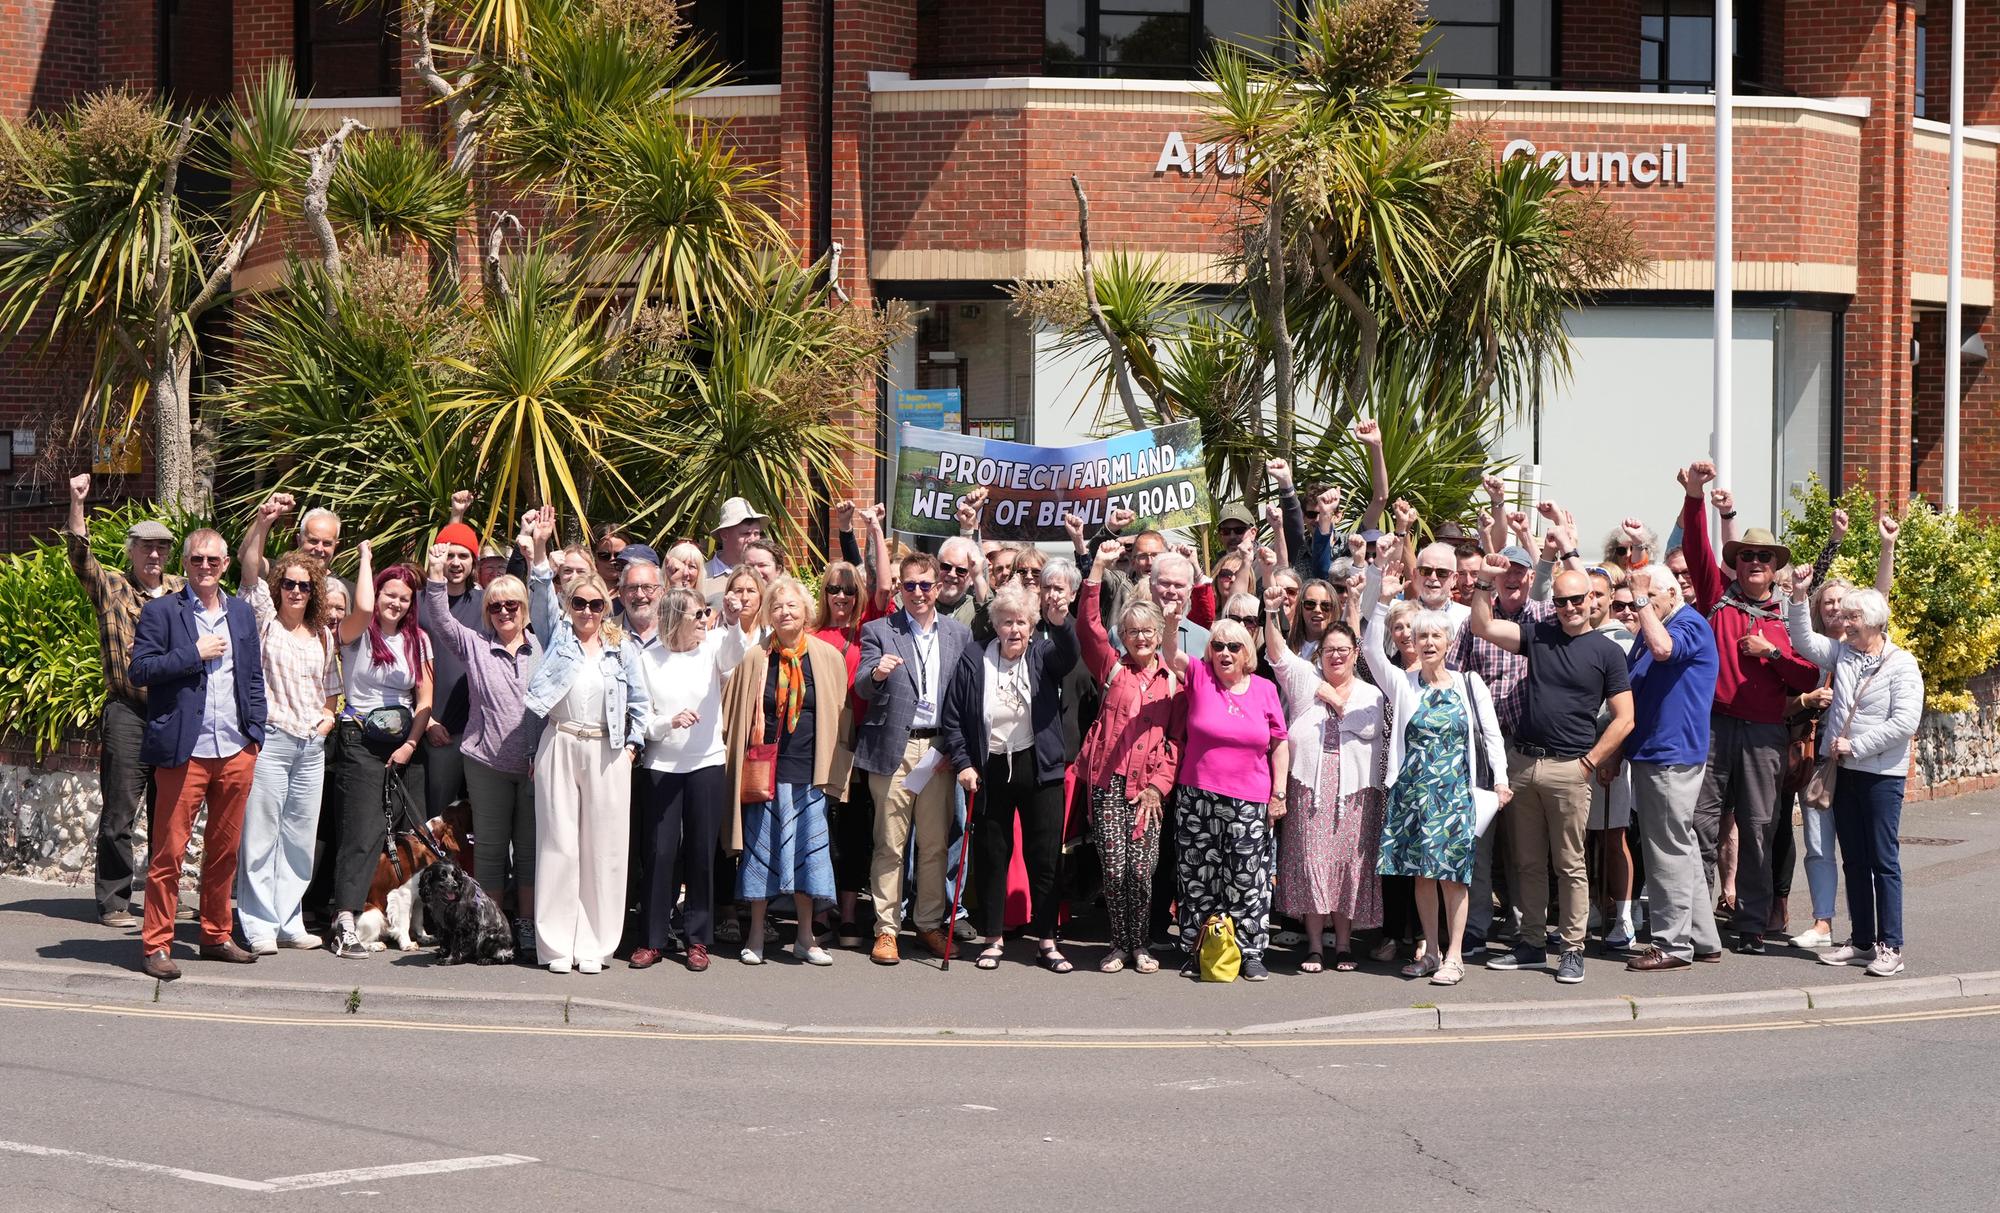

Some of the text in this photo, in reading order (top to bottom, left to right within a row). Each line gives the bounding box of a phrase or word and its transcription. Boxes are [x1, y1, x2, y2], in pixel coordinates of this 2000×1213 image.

[1502, 138, 1687, 183] Council
[938, 444, 1176, 491] PROTECT FARMLAND
[995, 499, 1032, 527] OF
[1037, 493, 1133, 527] BEWLEY
[1138, 480, 1196, 519] ROAD
